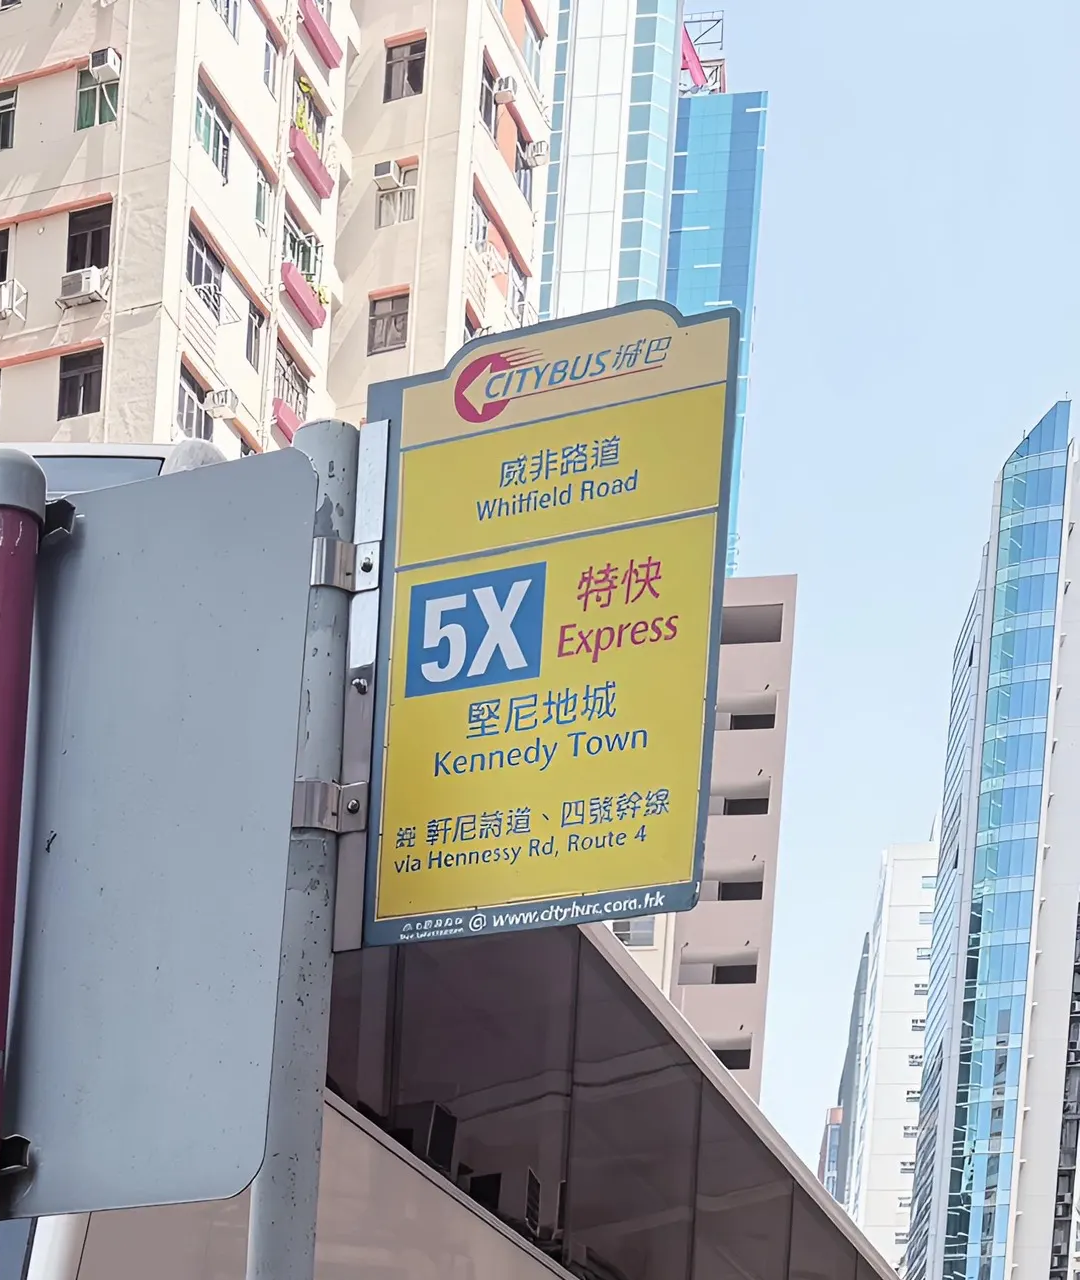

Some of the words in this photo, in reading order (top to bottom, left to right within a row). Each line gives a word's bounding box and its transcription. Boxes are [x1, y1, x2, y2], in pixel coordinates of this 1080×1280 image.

[485, 350, 613, 400] CITYBUS
[499, 435, 621, 488] 威非路道
[476, 483, 572, 521] Whitfield
[580, 469, 639, 502] Road
[576, 555, 662, 612] 特快
[420, 578, 533, 683] 5X
[557, 614, 679, 663] Express
[466, 681, 617, 739] 堅尼地城
[434, 737, 558, 777] Kennedy
[567, 729, 648, 757] Town
[394, 855, 422, 873] via
[428, 846, 522, 869] Hennessy
[528, 836, 559, 857] Rd,
[567, 831, 627, 852] Route
[634, 824, 647, 841] 4
